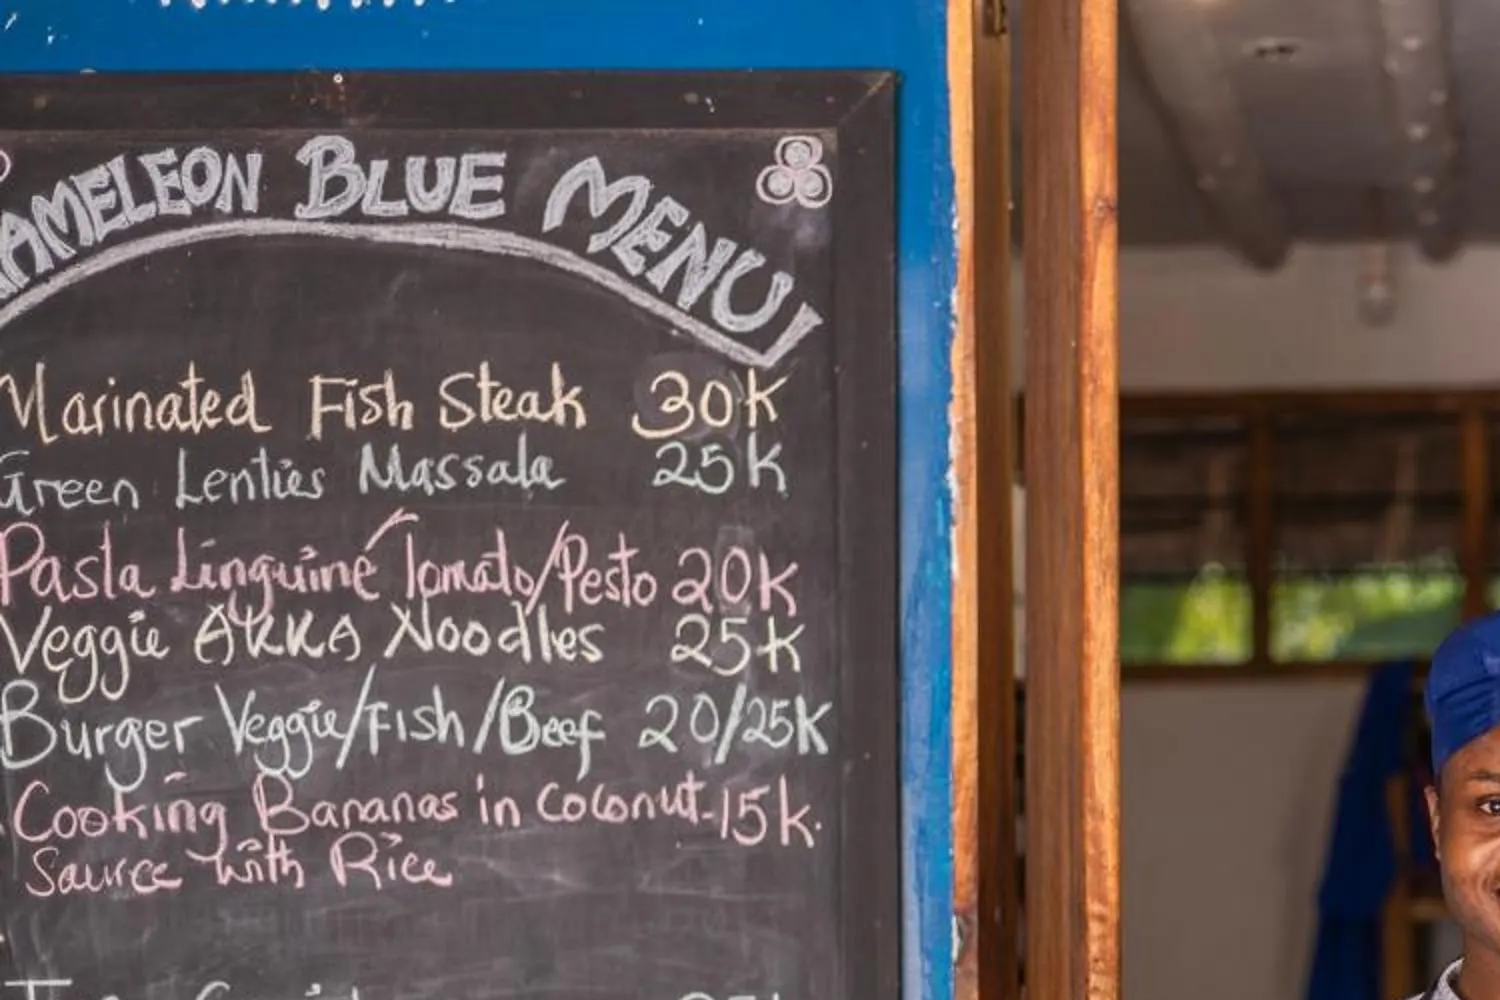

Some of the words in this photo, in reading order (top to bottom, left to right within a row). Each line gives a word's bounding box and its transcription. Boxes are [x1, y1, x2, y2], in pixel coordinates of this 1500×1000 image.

[0, 146, 262, 299] AMELEON
[295, 135, 507, 219] BLUE
[306, 369, 413, 440] Fish
[438, 361, 587, 432] Steak
[358, 431, 566, 496] Massala
[0, 521, 156, 603] Pasta
[0, 605, 170, 703] Veggie
[383, 600, 605, 665] Noodles
[0, 680, 203, 793] Burger
[14, 772, 227, 862] Cooking
[253, 772, 458, 834] Bananas
[479, 773, 521, 827] in
[216, 837, 304, 888] with
[330, 831, 453, 889] Rice
